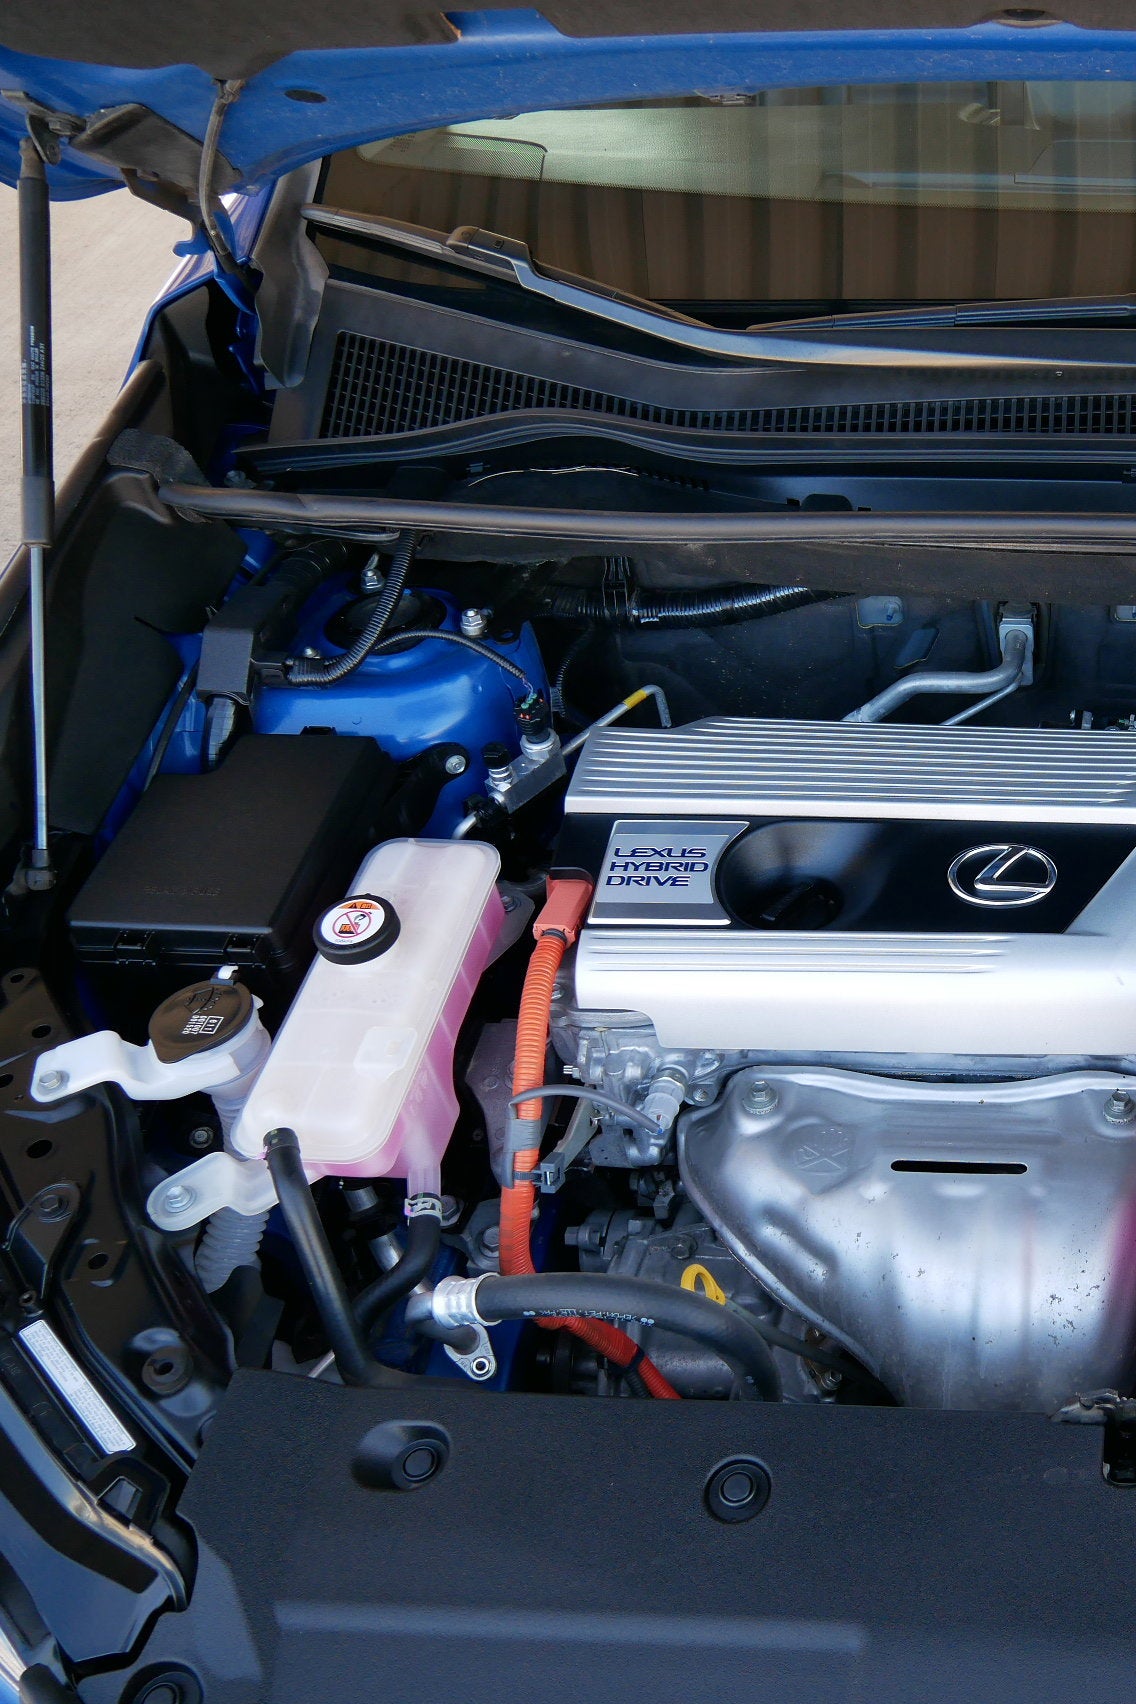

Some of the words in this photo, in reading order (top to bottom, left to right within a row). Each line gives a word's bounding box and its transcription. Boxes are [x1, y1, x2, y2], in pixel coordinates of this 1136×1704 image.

[613, 847, 707, 858] LEXUS
[609, 861, 709, 872] HYBRID
[605, 875, 691, 887] DRIVE
